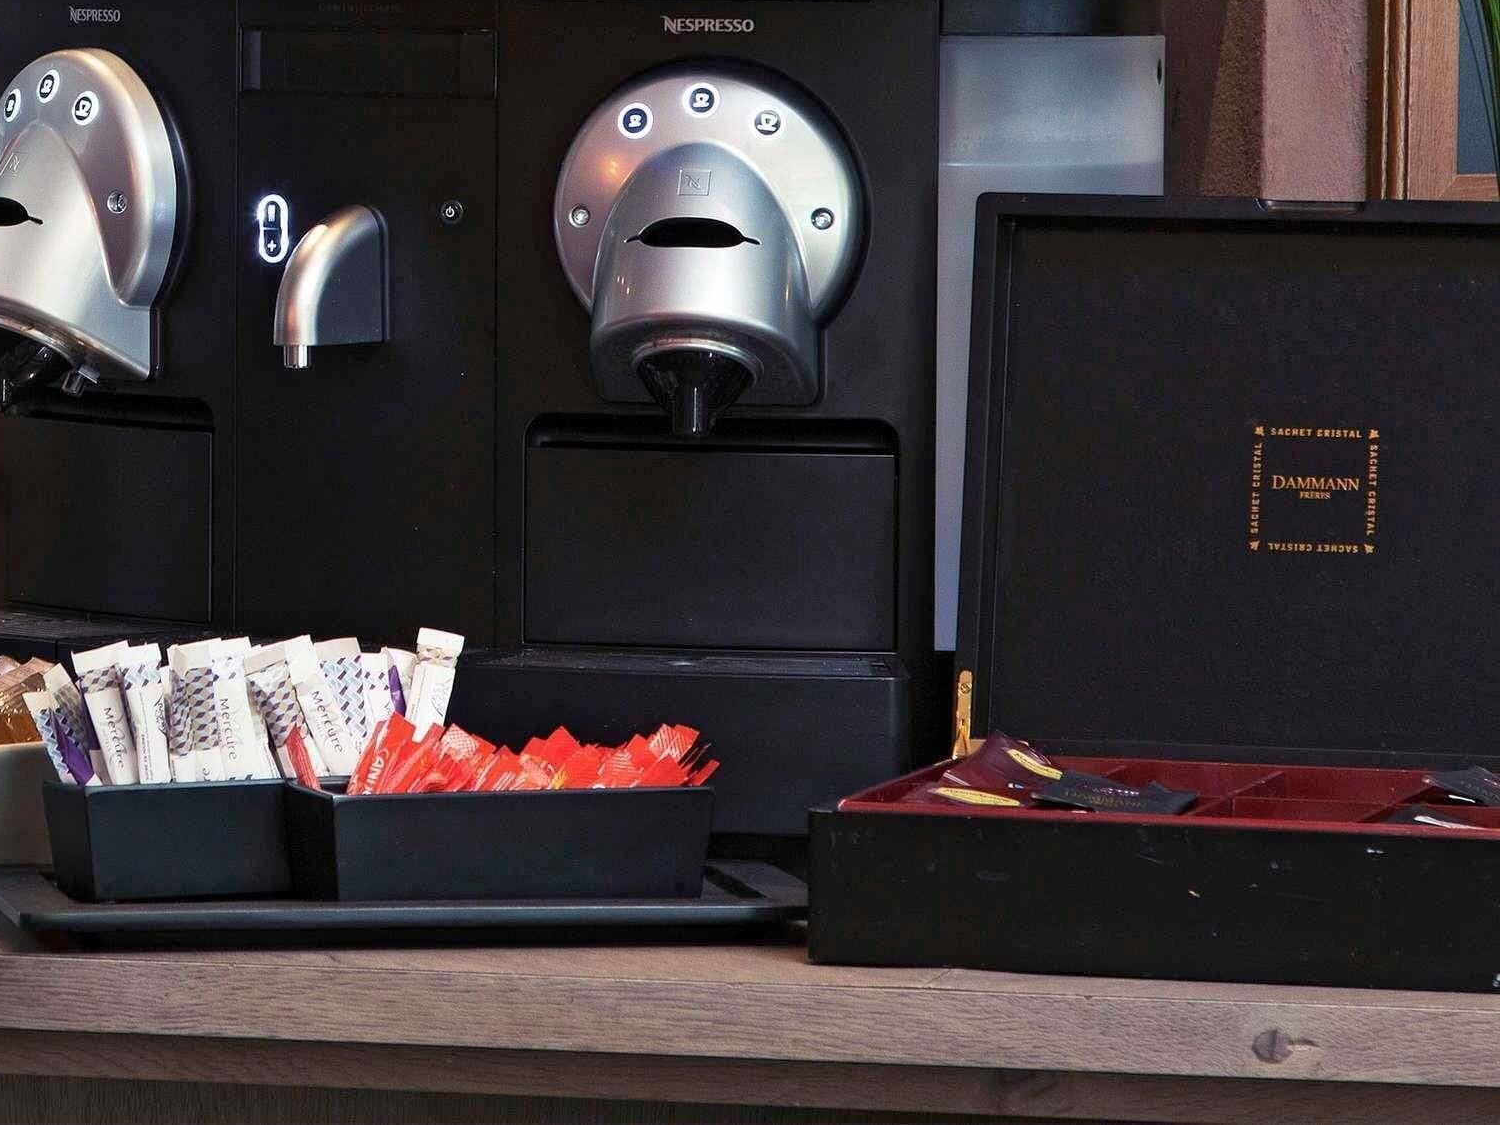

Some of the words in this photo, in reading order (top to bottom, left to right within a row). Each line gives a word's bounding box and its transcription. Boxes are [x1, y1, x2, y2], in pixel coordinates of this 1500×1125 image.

[70, 6, 121, 23] NESPRESSO
[661, 16, 755, 34] NESPRESSO
[1270, 427, 1312, 437] SACHET
[1316, 428, 1362, 438] CRISTAL
[1252, 442, 1263, 487] CRISTAL
[1272, 475, 1360, 490] DAMMANN
[1368, 444, 1379, 486] SACHET
[1250, 492, 1260, 534] SACHET
[1367, 491, 1377, 535] CRISTAL
[1267, 542, 1312, 552] CRISTAL
[1316, 543, 1359, 553] SACHET
[103, 707, 125, 769] Mercure
[219, 698, 237, 762] Mercure
[312, 690, 344, 754] Mercure
